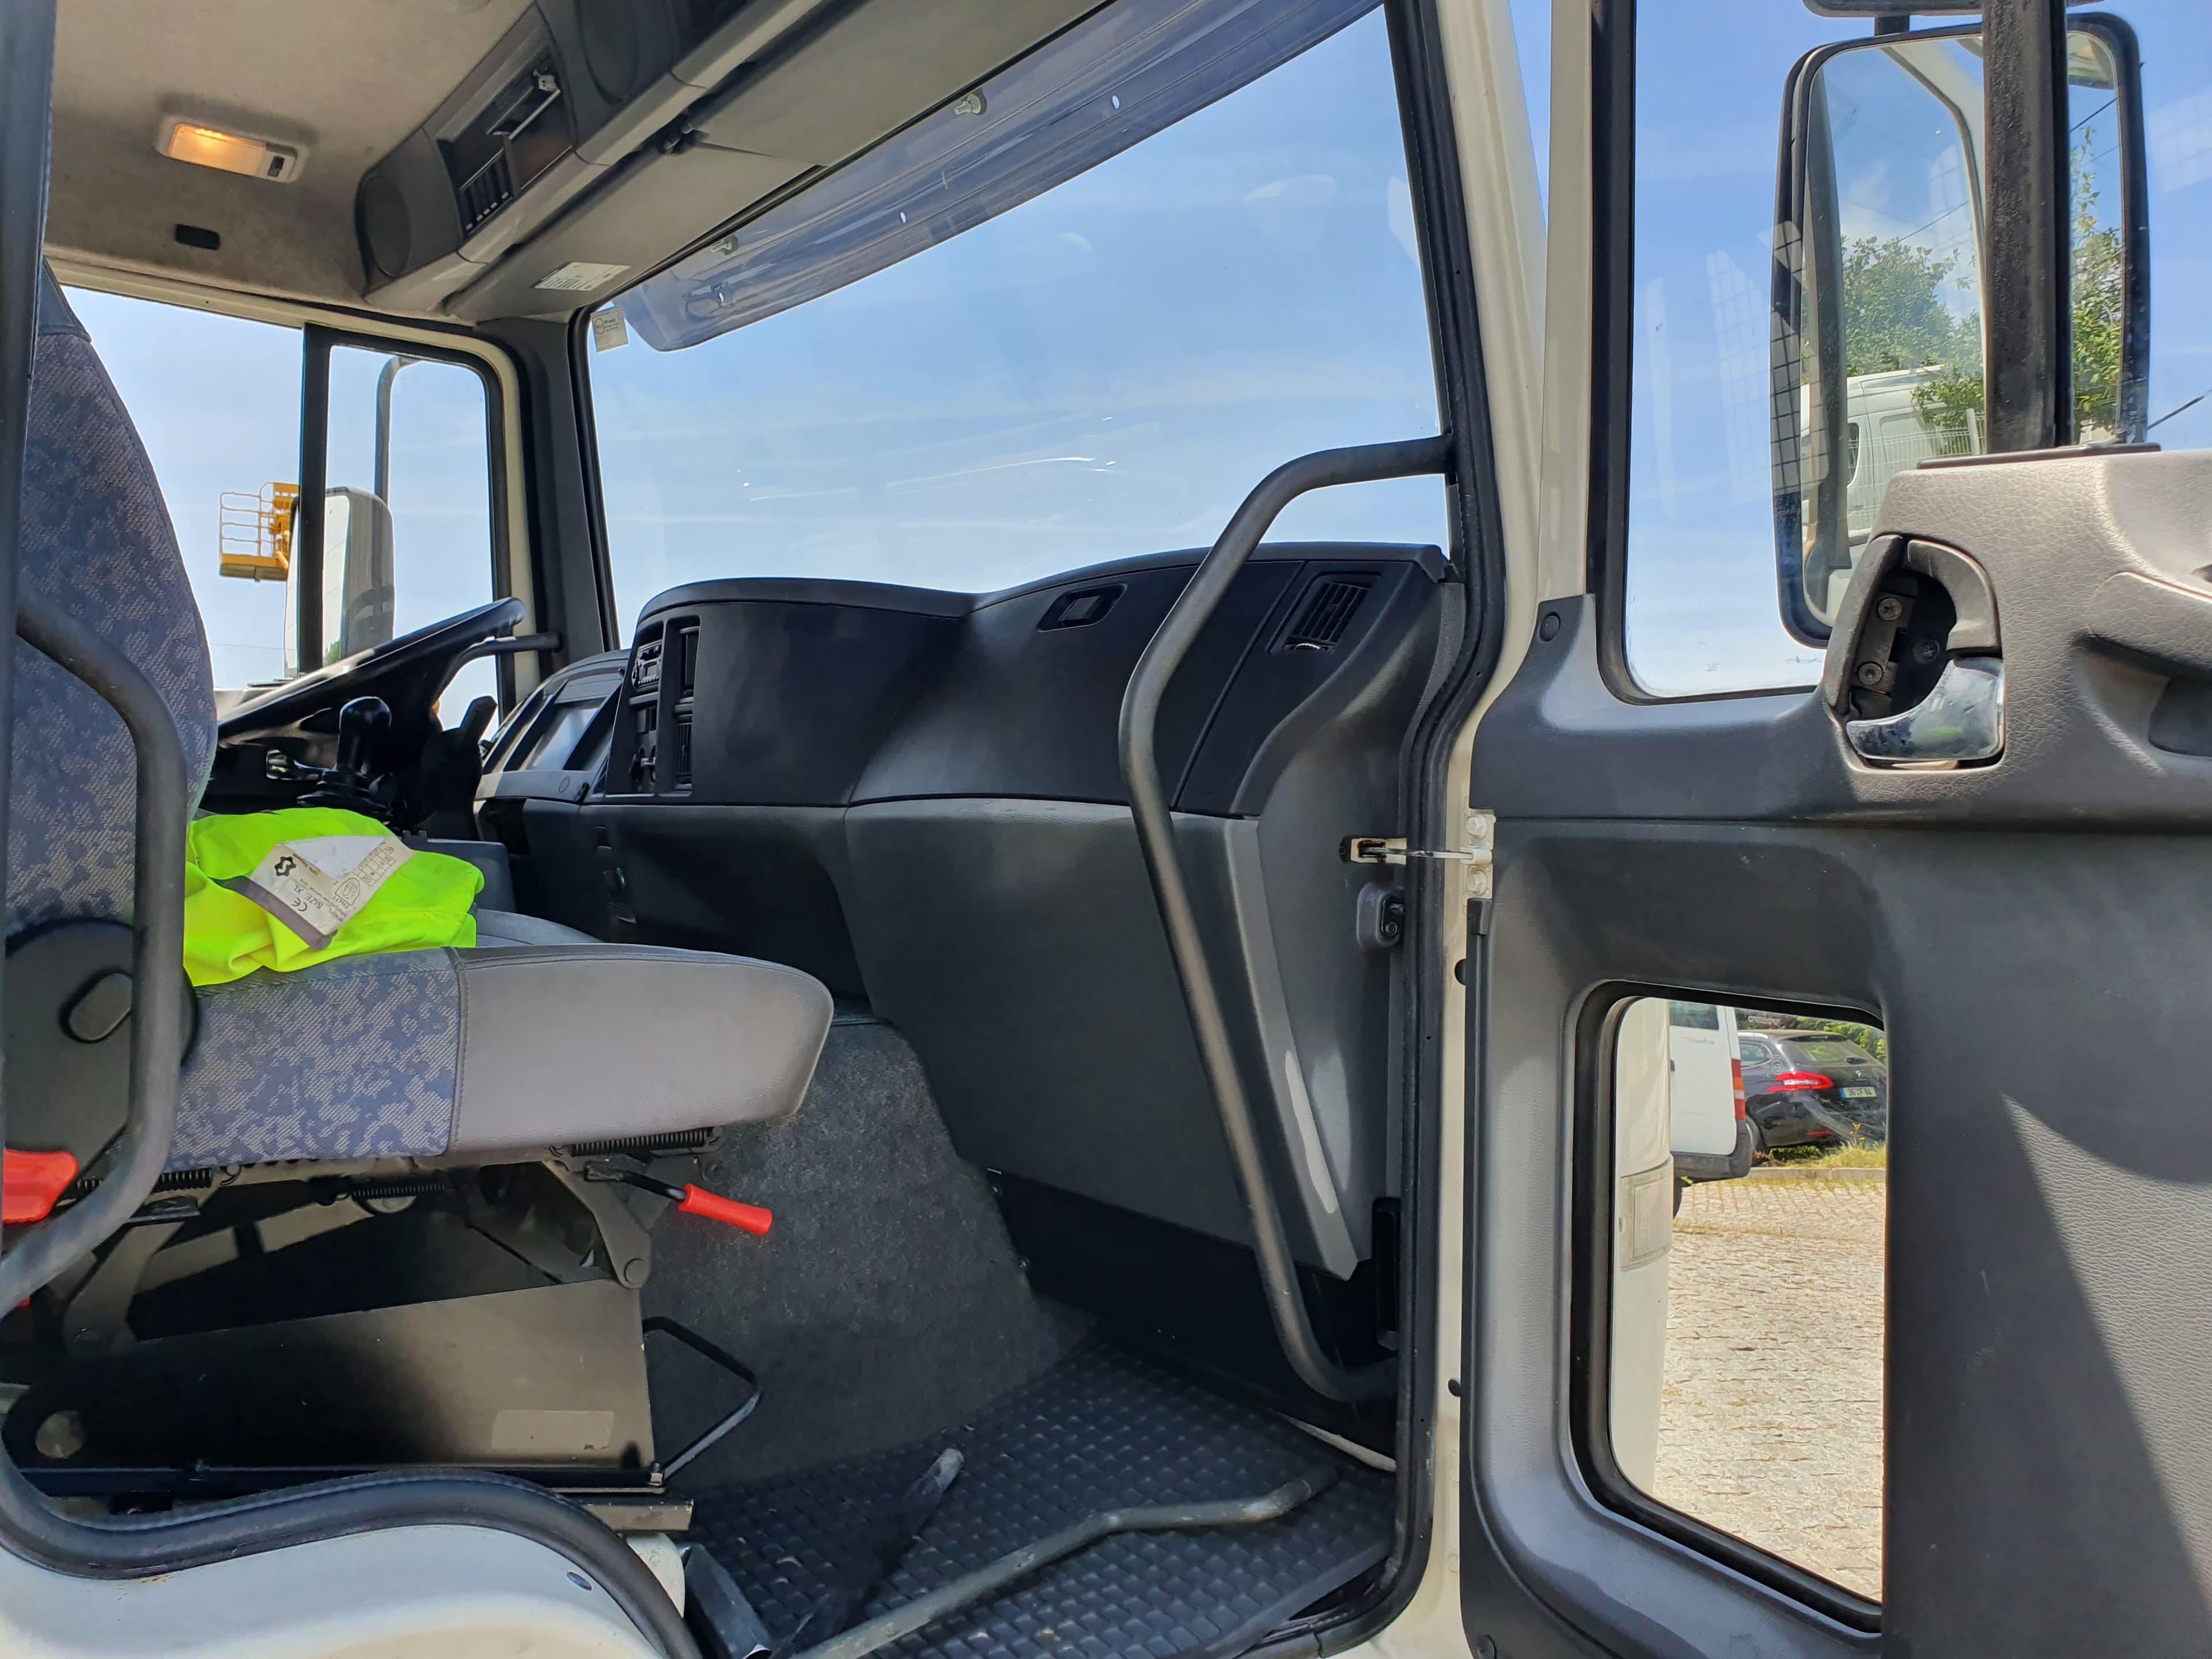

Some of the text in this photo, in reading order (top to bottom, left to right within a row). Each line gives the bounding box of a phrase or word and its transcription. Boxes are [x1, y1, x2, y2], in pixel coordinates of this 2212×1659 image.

[293, 883, 304, 894] XL
[292, 897, 308, 912] CE
[305, 892, 324, 910] SIZE:
